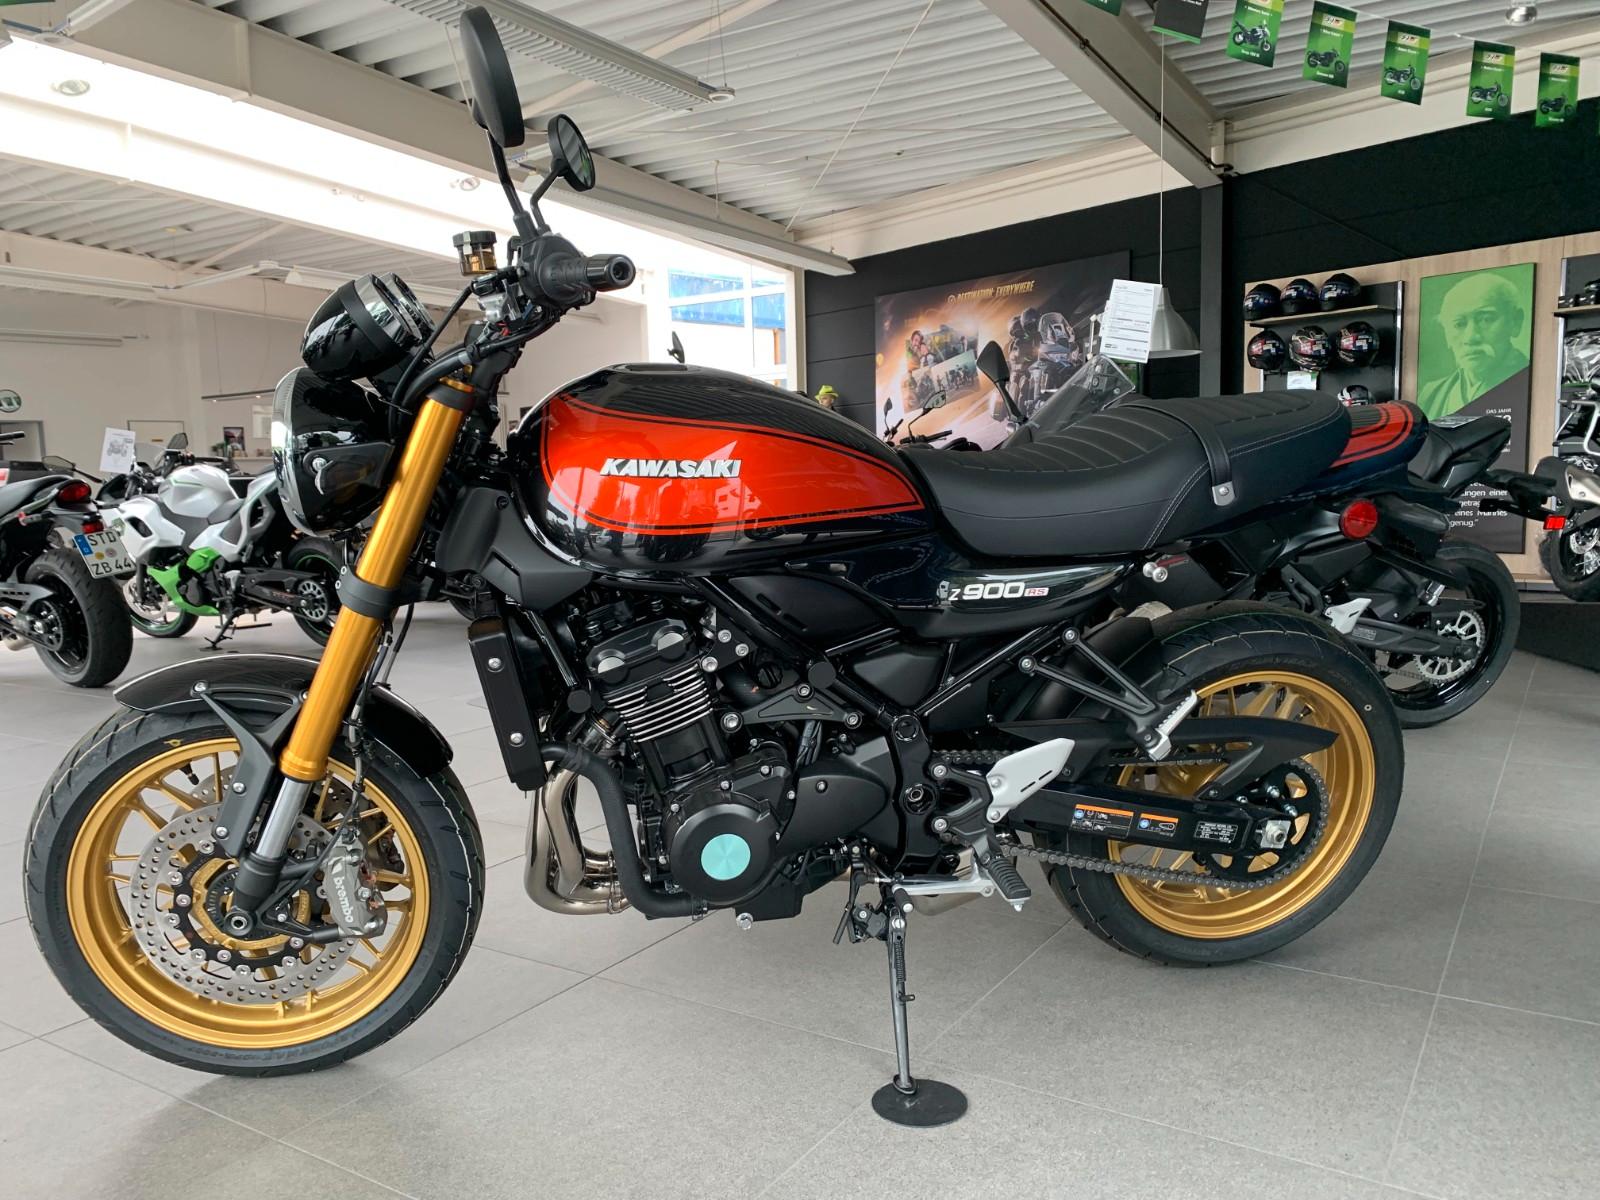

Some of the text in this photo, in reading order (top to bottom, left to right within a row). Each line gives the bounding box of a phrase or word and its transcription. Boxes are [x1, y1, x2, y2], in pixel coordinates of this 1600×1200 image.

[600, 458, 742, 478] KAWASAKI
[87, 531, 117, 546] STD
[91, 558, 131, 575] ZB 44
[333, 876, 354, 923] brembo
